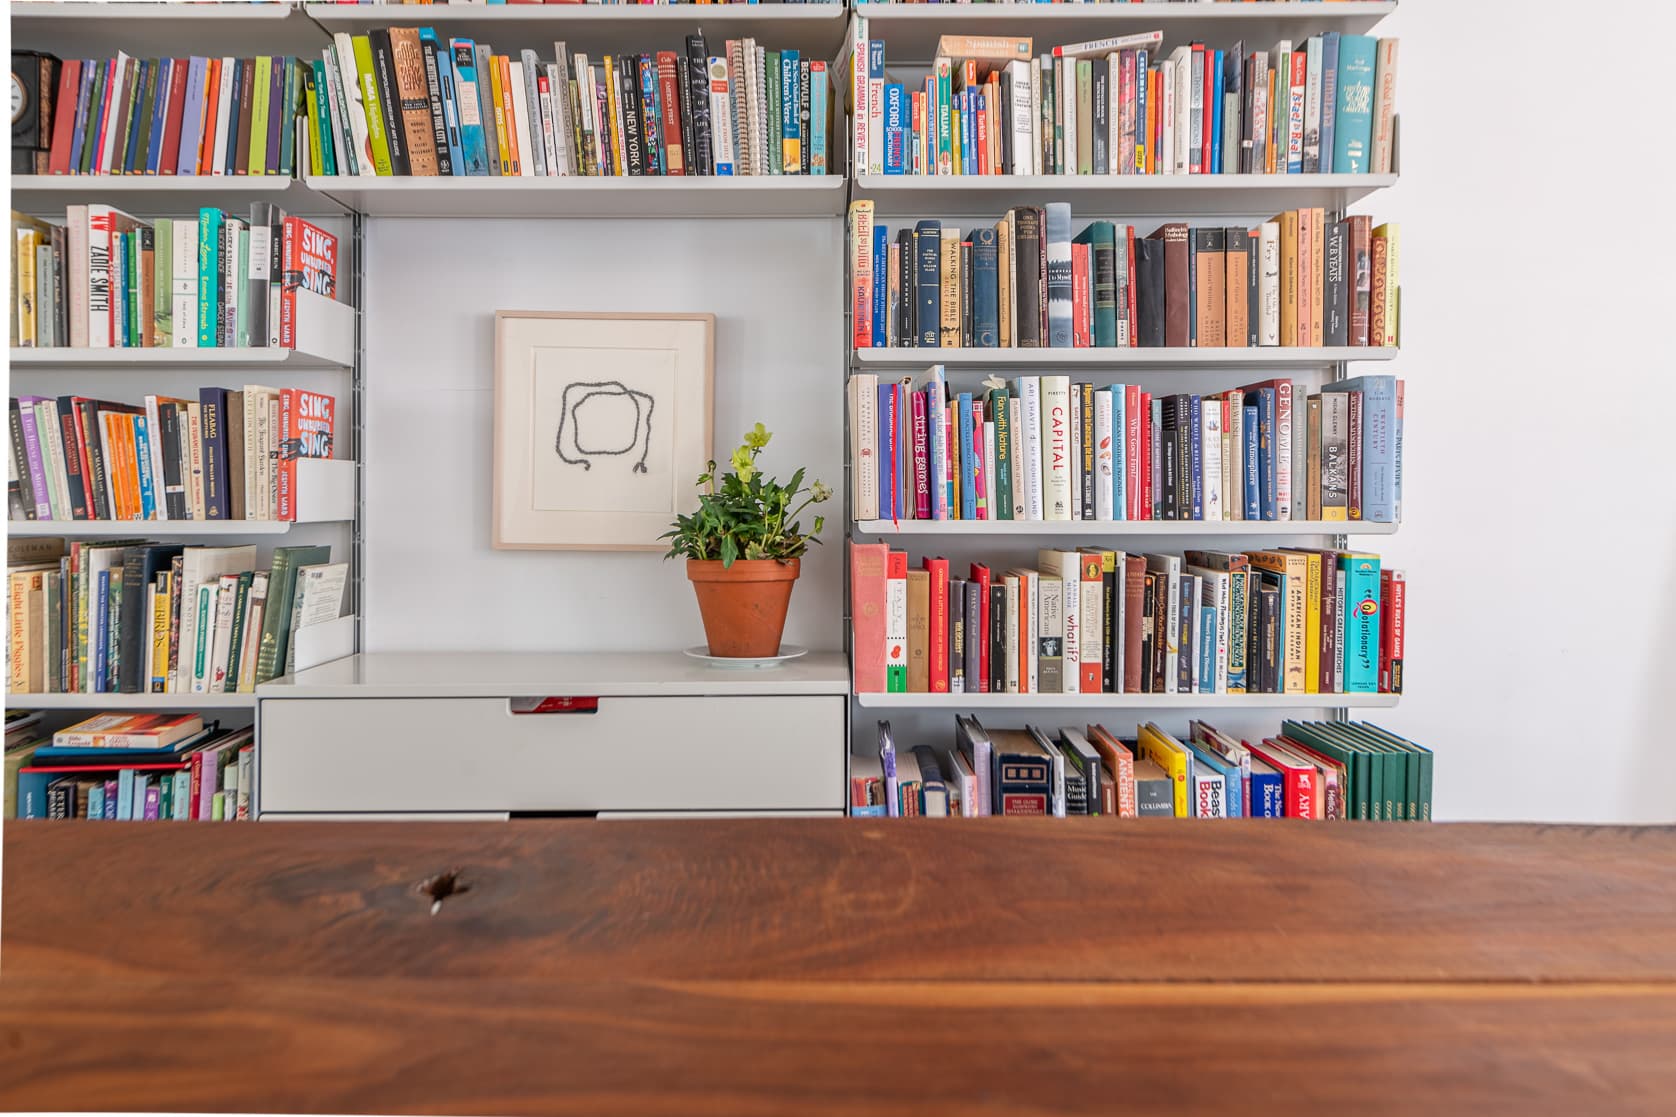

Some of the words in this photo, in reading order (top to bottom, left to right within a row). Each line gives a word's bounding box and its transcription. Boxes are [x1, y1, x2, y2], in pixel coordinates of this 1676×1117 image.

[856, 42, 866, 73] SPANISH
[363, 73, 376, 101] MoMA
[665, 80, 673, 109] AMERICA
[800, 61, 809, 108] BEOWULF
[856, 75, 866, 111] GRAMMAR
[783, 102, 791, 124] Verse
[871, 82, 882, 118] French
[888, 88, 901, 127] OXFORD
[1291, 91, 1303, 123] Israel
[626, 111, 637, 137] NEW
[666, 109, 674, 125] FIRST
[940, 104, 949, 137] ITALIAN
[856, 122, 866, 149] REVIEW
[892, 131, 902, 167] FRENCH
[1290, 132, 1302, 155] Real
[629, 137, 640, 166] YORK
[90, 215, 109, 232] NW
[90, 246, 109, 274] ZADIE
[1329, 256, 1338, 282] YEATS
[90, 278, 109, 312] SMITH
[283, 324, 291, 344] WARD
[997, 396, 1006, 412] Fun
[208, 403, 217, 439] FLEABAG
[914, 415, 928, 452] string
[997, 412, 1007, 431] with
[1279, 382, 1291, 465] GENOME
[998, 431, 1008, 460] Nature
[1052, 407, 1064, 471] CAPITAL
[916, 456, 929, 494] games
[1248, 441, 1258, 486] Atmosphere
[1328, 446, 1338, 498] BALKANS
[14, 583, 25, 610] Eight
[1050, 594, 1059, 619] Native
[1336, 587, 1344, 618] HISTORY'S
[14, 611, 25, 638] Little
[154, 609, 166, 649] BIRDS
[1043, 594, 1052, 636] Americans
[1066, 614, 1078, 645] what
[1294, 631, 1302, 660] INDIAN
[1336, 618, 1344, 646] GREATEST
[1394, 627, 1401, 637] OF
[13, 640, 25, 679] Piggies
[1066, 647, 1079, 663] if?
[1335, 646, 1343, 674] SPEECHES
[1393, 637, 1401, 658] GAMES
[1118, 758, 1129, 810] ANCIENT
[1140, 802, 1173, 810] COLUMBIA
